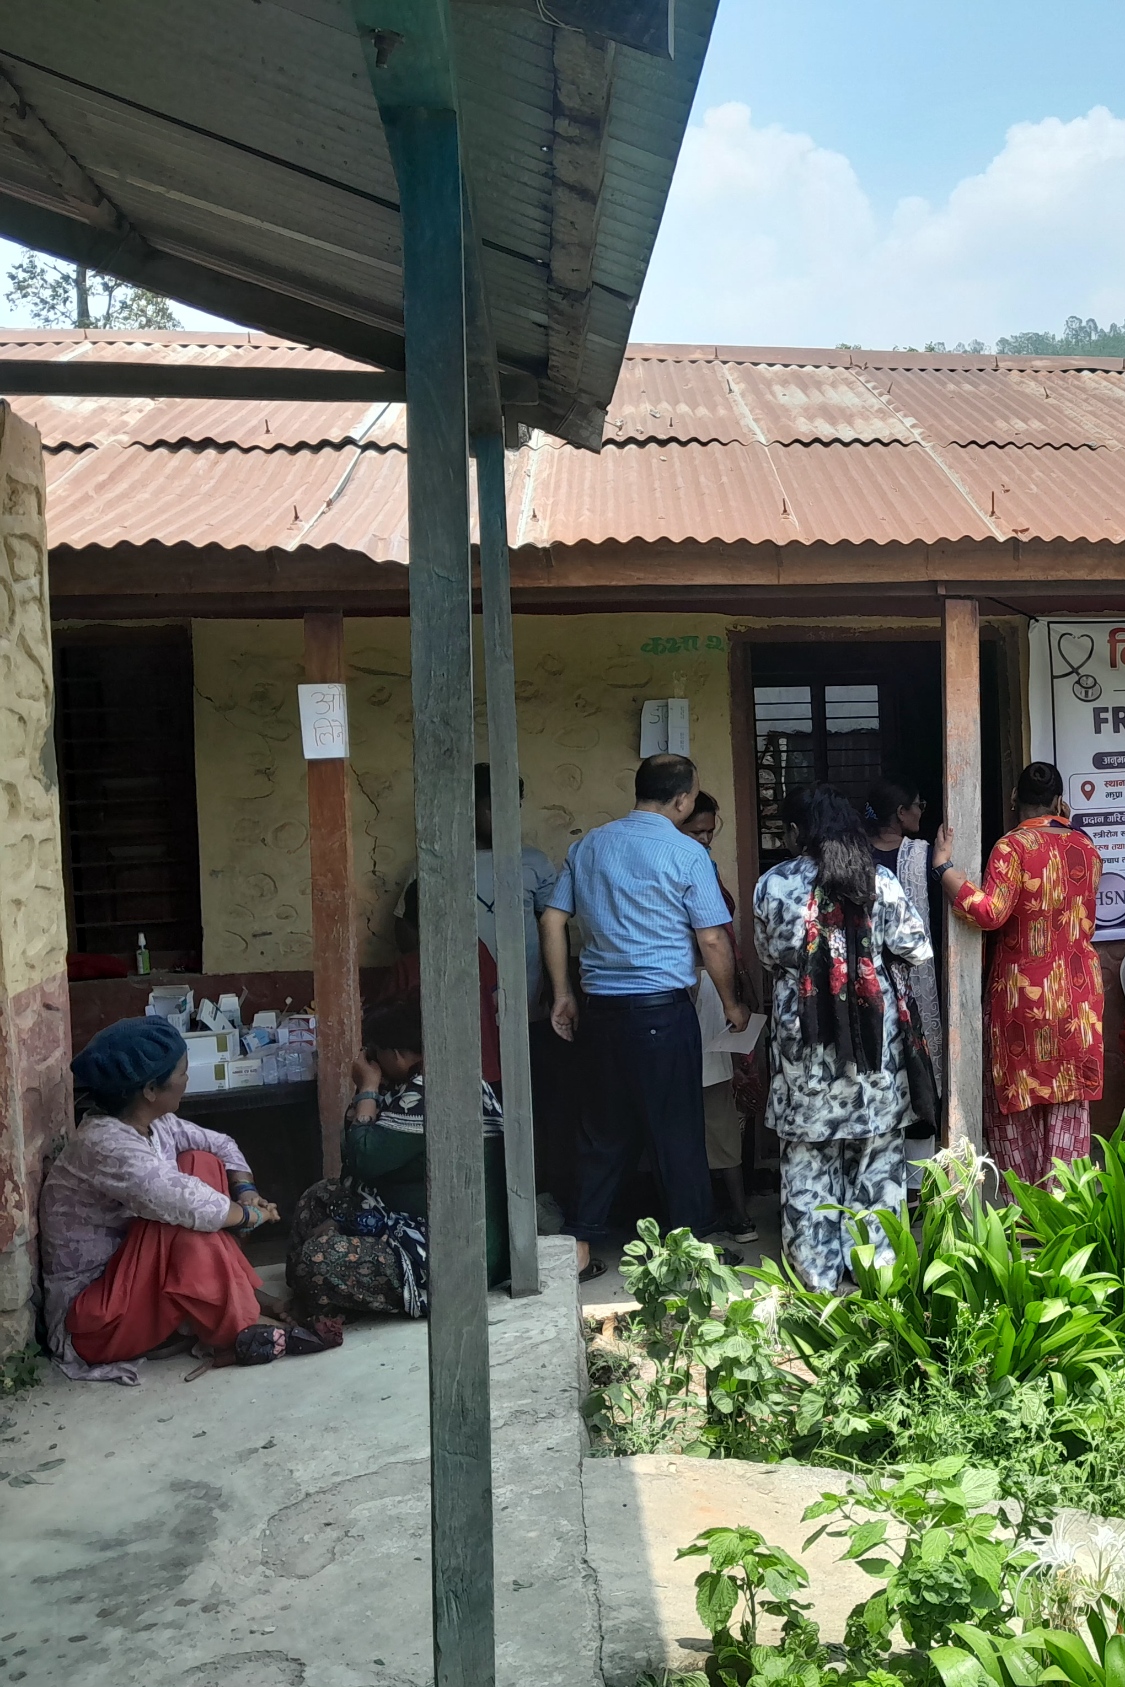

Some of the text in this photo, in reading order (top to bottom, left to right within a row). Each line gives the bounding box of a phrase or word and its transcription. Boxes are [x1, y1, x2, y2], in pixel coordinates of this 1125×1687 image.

[1083, 816, 1104, 825] प्रदान
[1093, 830, 1118, 839] स्त्रीरोग
[1111, 843, 1125, 851] तथा
